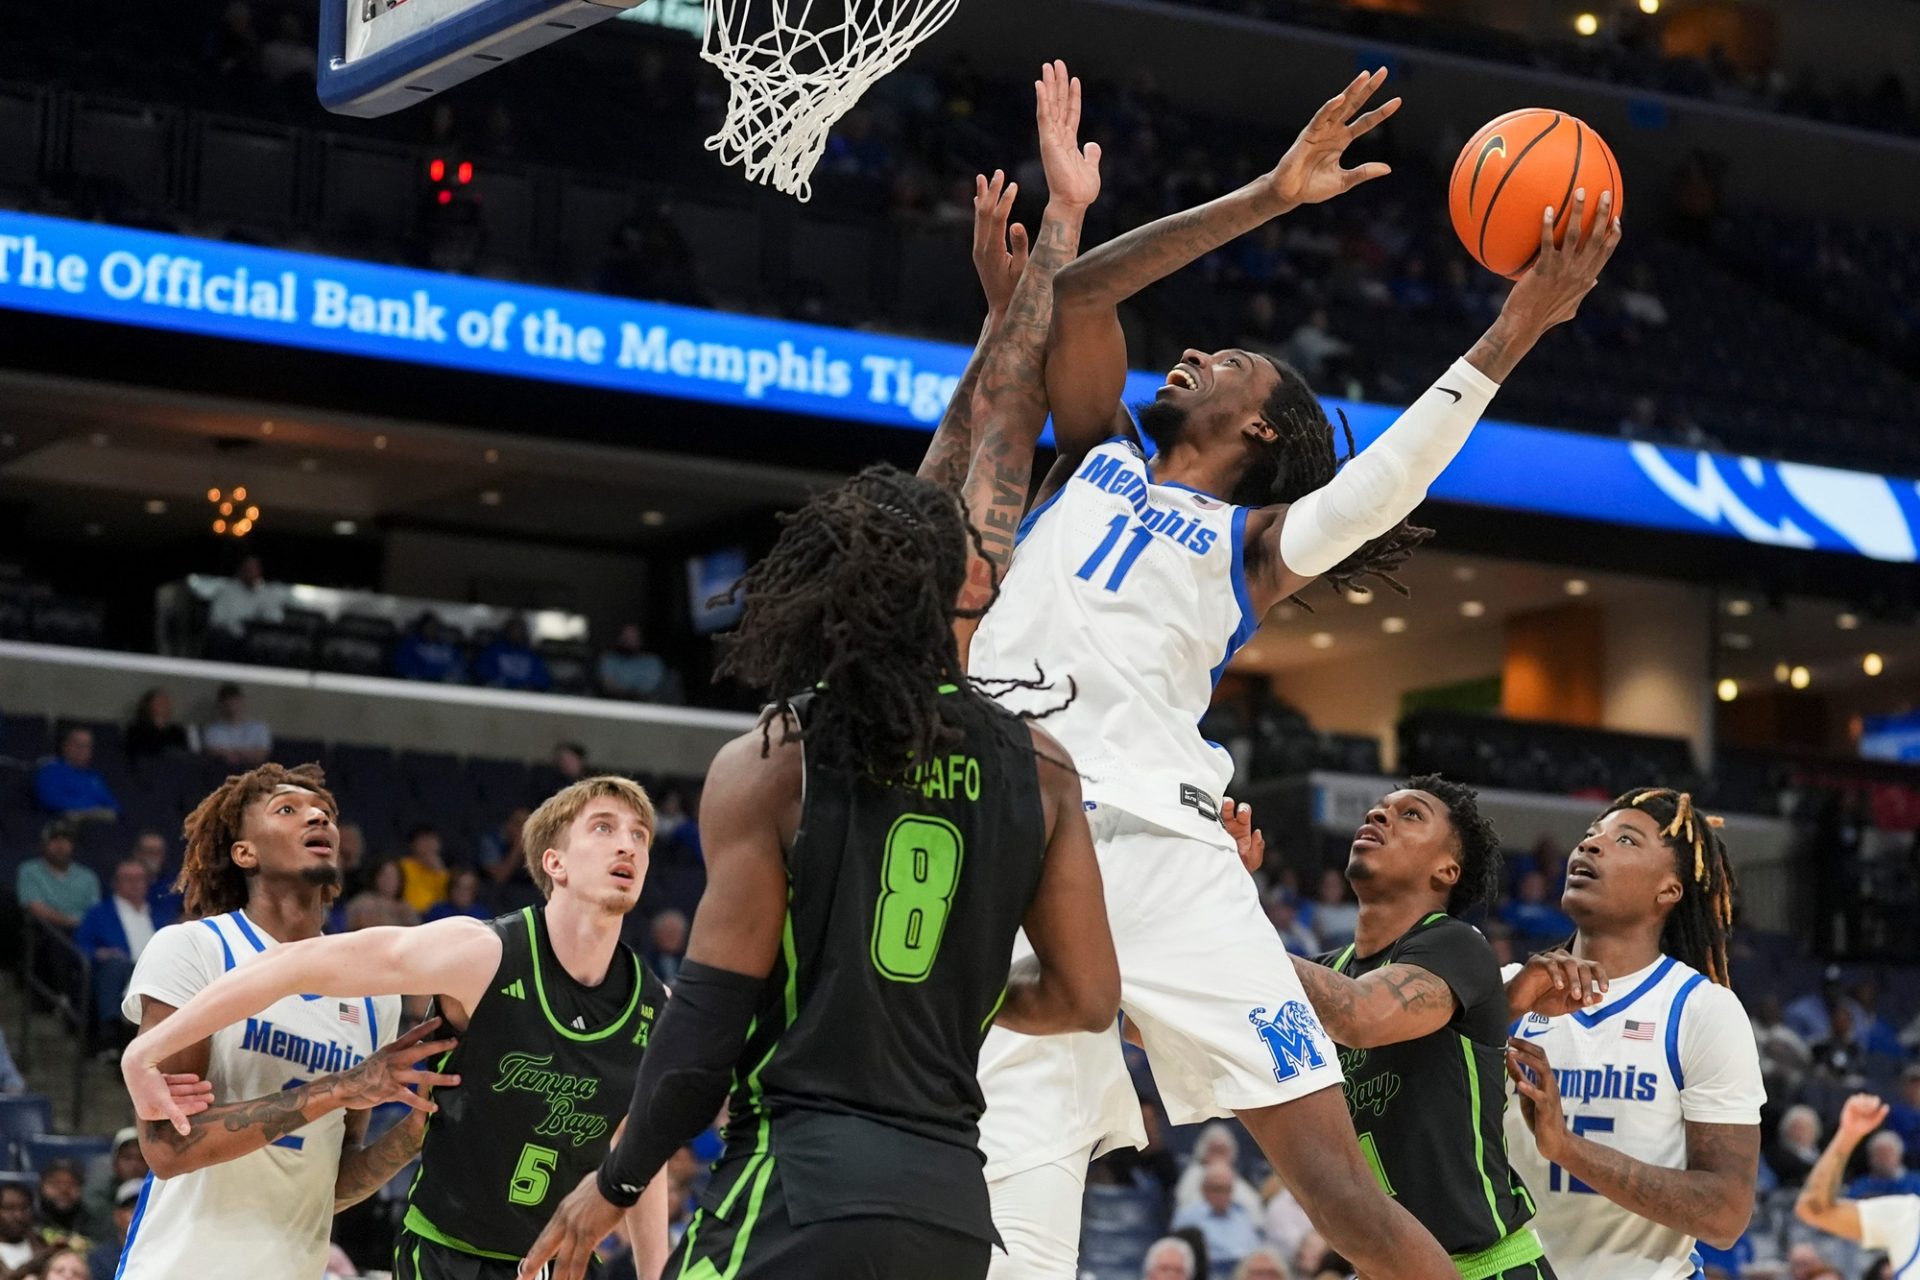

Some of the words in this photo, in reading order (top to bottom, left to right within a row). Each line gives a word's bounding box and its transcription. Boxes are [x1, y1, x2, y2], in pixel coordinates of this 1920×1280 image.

[0, 234, 88, 293] The
[100, 250, 298, 323] Official
[312, 279, 446, 342] Bank
[457, 302, 516, 351] of
[521, 308, 604, 364] the
[616, 321, 852, 398] Memphis
[1075, 453, 1218, 556] Memphis
[1074, 513, 1154, 593] 11
[870, 812, 964, 983] 8
[492, 1053, 600, 1103] Tampa
[1513, 1063, 1658, 1105] mphis
[534, 1096, 608, 1147] Bay
[508, 1142, 558, 1206] 5
